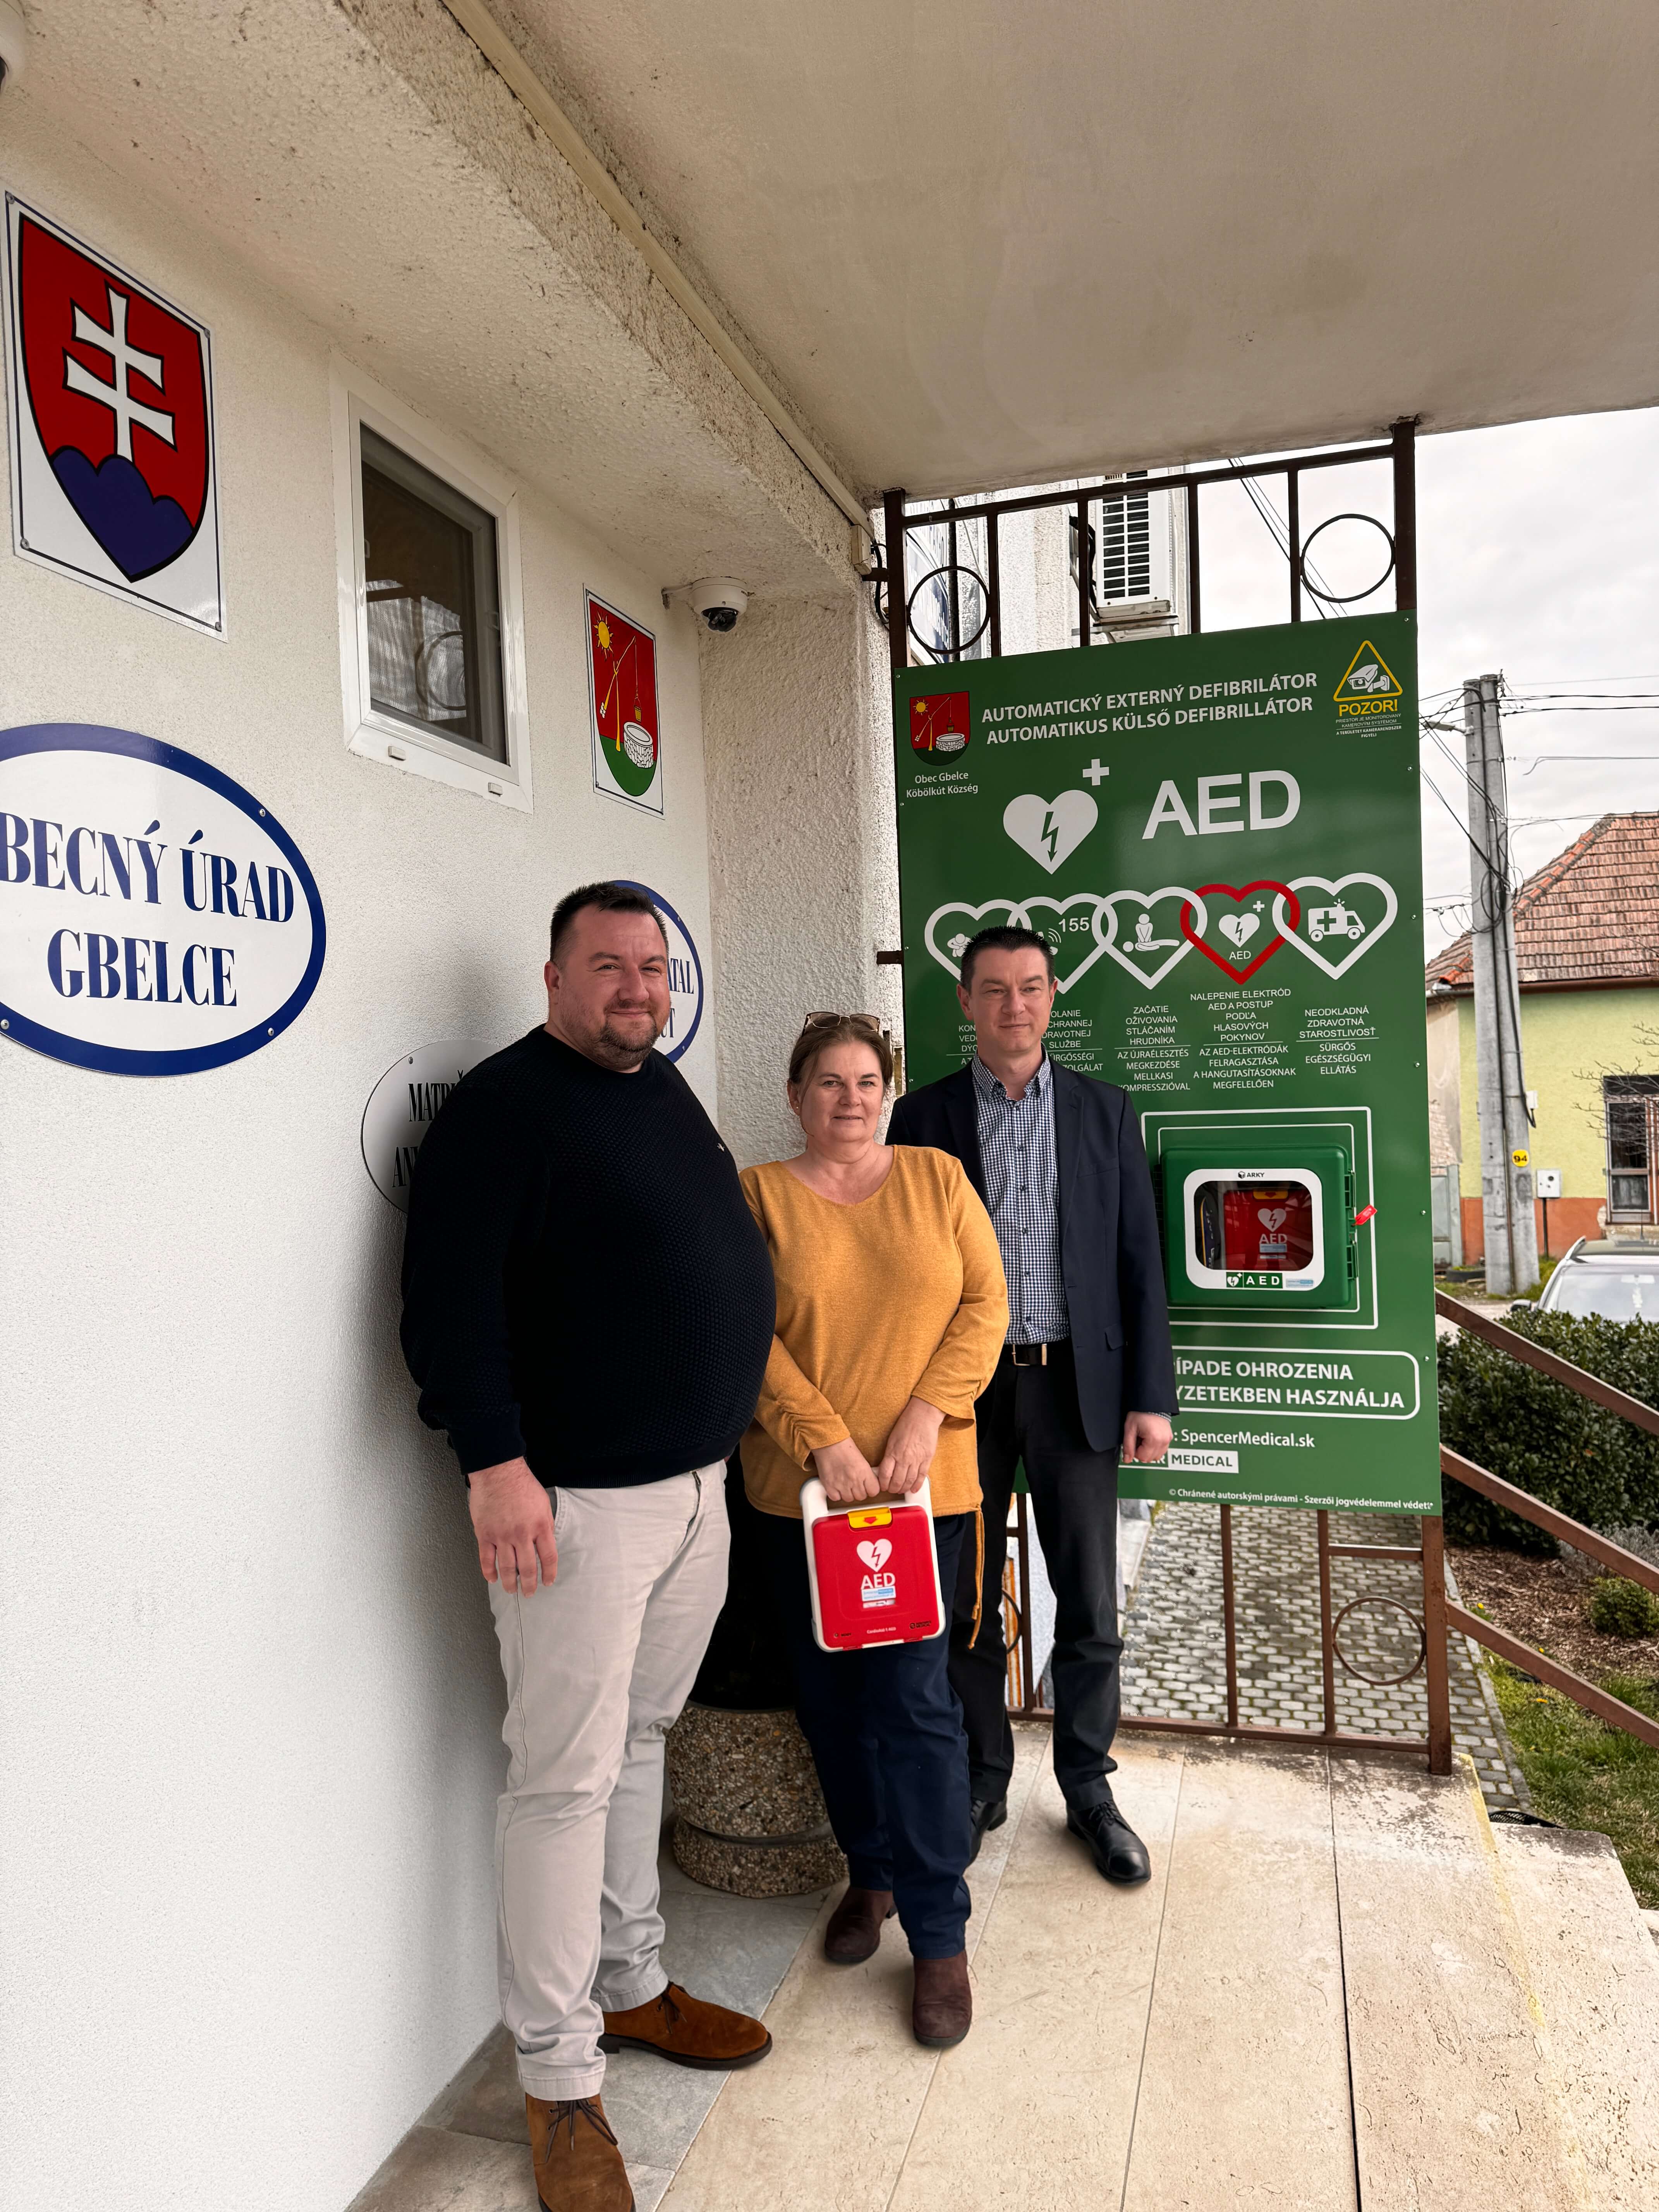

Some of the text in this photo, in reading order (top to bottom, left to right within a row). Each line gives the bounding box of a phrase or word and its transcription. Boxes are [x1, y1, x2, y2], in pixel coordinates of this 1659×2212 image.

[981, 673, 1317, 723] AUTOMATICKÝ EXTERNÝ DEFIBRILÁTOR
[1339, 699, 1398, 717] POZOR!
[986, 697, 1313, 745] AUTOMATIKUS KÜLSŐ DEFIBRILLÁTOR
[915, 772, 969, 784] Obec Gbelce
[906, 784, 979, 798] Köbölkút Község
[1142, 770, 1301, 840] AED
[0, 812, 294, 922] BECNÝ ÚRAD
[1058, 917, 1090, 932] 155
[1229, 951, 1251, 960] AED
[47, 929, 237, 1006] GBELCE
[667, 958, 694, 994] ATAL
[1190, 988, 1291, 1001] NALEPENIE ELEKTRÓD
[1133, 1005, 1169, 1014] ZAČATIE
[1236, 1000, 1273, 1009] POSTUP
[1226, 1012, 1256, 1020] PODĽA
[1305, 1005, 1369, 1017] NEODKLADNÁ
[1048, 1020, 1092, 1028] CHRANNEJ
[1126, 1015, 1178, 1025] OŽIVOVANIA
[1307, 1016, 1364, 1027] ZDRAVOTNÁ
[1126, 1025, 1175, 1035] STLÁČANÍM
[1214, 1022, 1269, 1032] HLASOVÝCH
[1042, 1030, 1091, 1039] DRAVOTNEJ
[1220, 1033, 1265, 1042] POKYNOV
[1299, 1027, 1376, 1039] STAROSTLIVOSŤ
[1049, 1040, 1081, 1049] SLUŽBE
[1130, 1036, 1175, 1045] HRUDNÍKA
[1199, 1045, 1288, 1056] AZ AED-ELEKTRÓDÁK
[1319, 1041, 1356, 1052] SÜRGŐS
[1130, 1048, 1189, 1059] ÚJRAÉLESZTÉS
[1305, 1053, 1371, 1064] EGÉSZSÉGÜGYI
[1127, 1060, 1180, 1070] MEGKEZDÉSE
[1209, 1056, 1279, 1067] FELRAGASZTÁSA
[1201, 1067, 1296, 1078] HANGUTASÍTÁSOKNAK
[1320, 1065, 1357, 1075] ELLÁTÁS
[1134, 1072, 1173, 1080] MELLKASI
[1213, 1079, 1274, 1089] MEGFELELŐEN
[1259, 1233, 1288, 1244] AED
[1246, 1276, 1280, 1285] AED
[1176, 1357, 1353, 1381] ÍPADE OHROZENIA
[1176, 1385, 1405, 1408] YZETEKBEN HASZNÁLJA
[1181, 1429, 1315, 1448] SpencerMedical.sk
[1171, 1454, 1233, 1467] MEDICAL
[1178, 1488, 1216, 1499] Chránené
[1218, 1491, 1262, 1502] autorskými
[1264, 1493, 1298, 1503] právami
[1305, 1494, 1334, 1505] Szerzői
[1335, 1496, 1401, 1509] jogvédelemmel
[861, 1572, 896, 1589] AED
